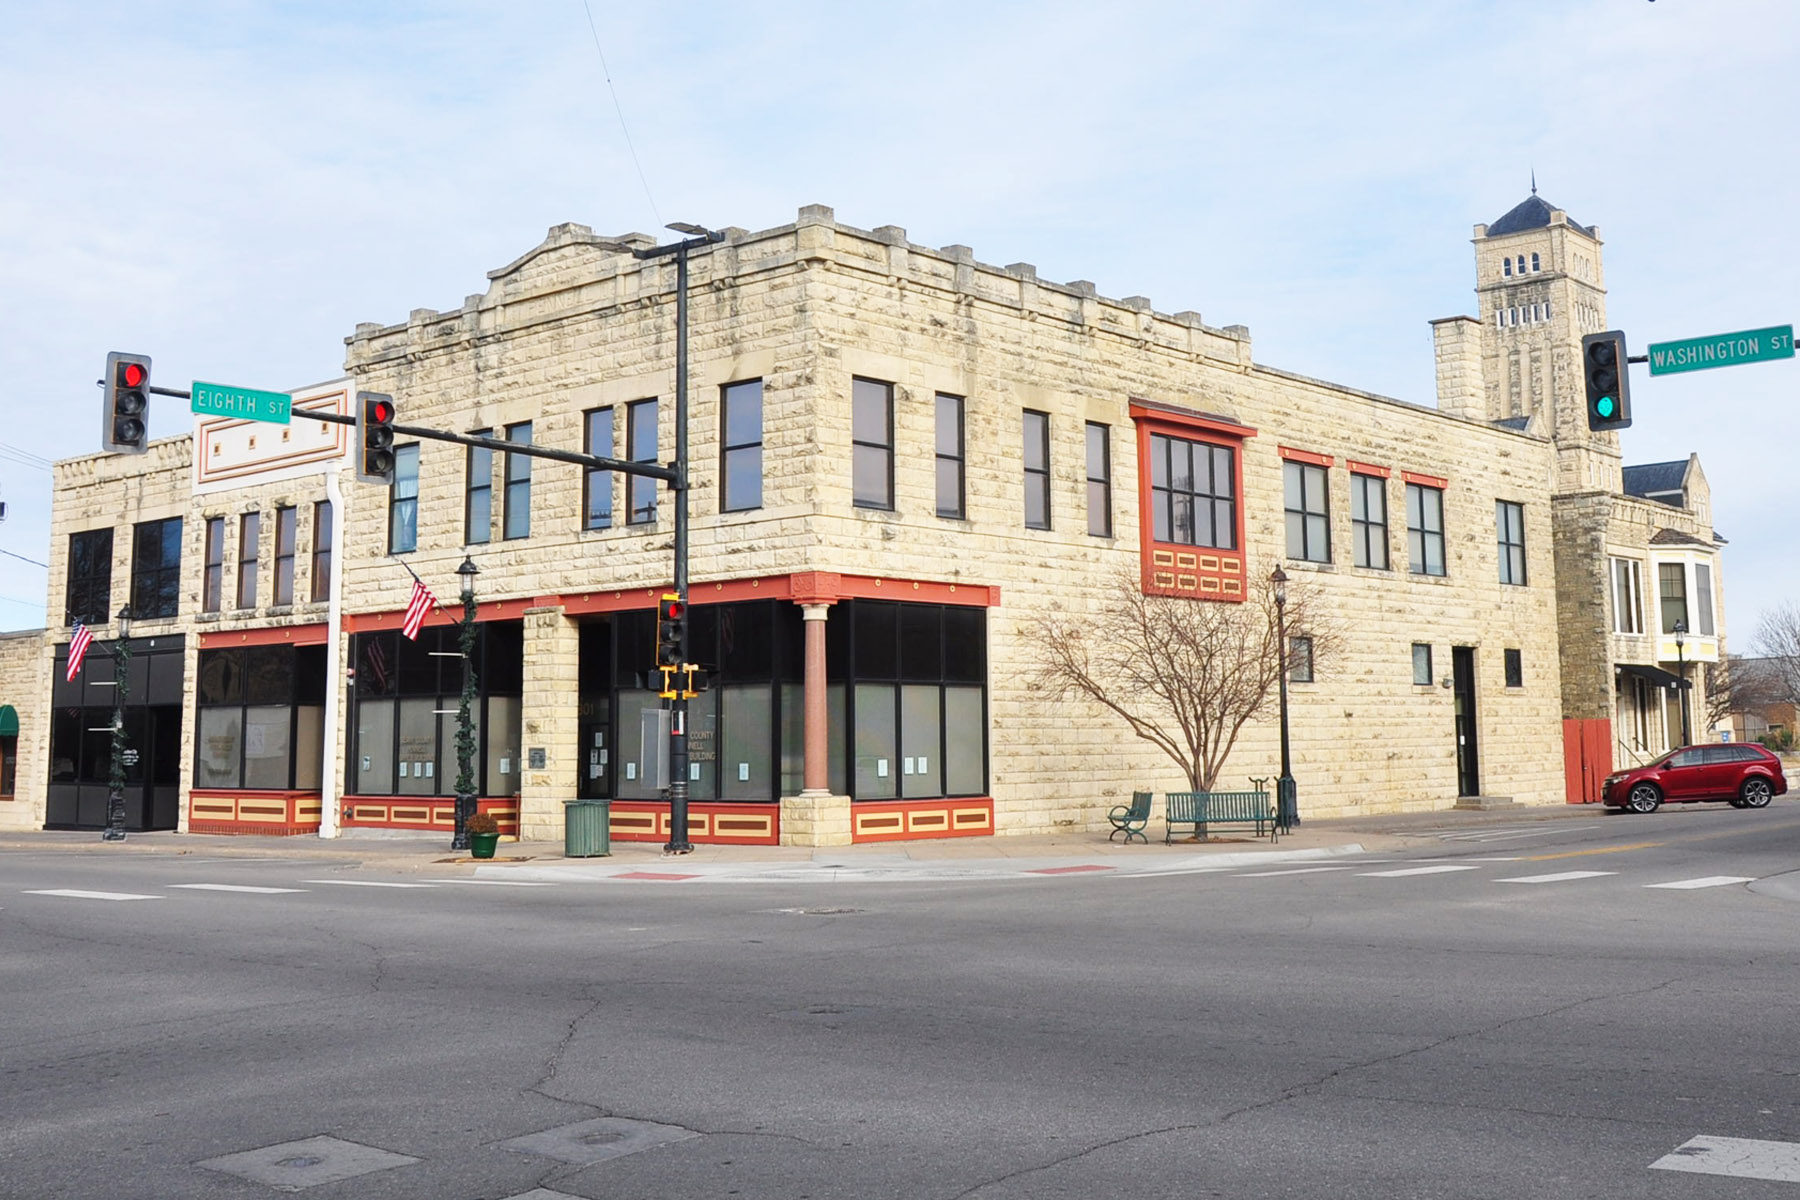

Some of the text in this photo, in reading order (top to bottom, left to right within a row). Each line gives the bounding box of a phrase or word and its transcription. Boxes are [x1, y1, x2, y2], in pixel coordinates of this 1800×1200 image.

[1653, 335, 1789, 368] WASHINGTON ST
[198, 390, 284, 415] EIGHTH ST
[689, 730, 714, 740] COUNTY
